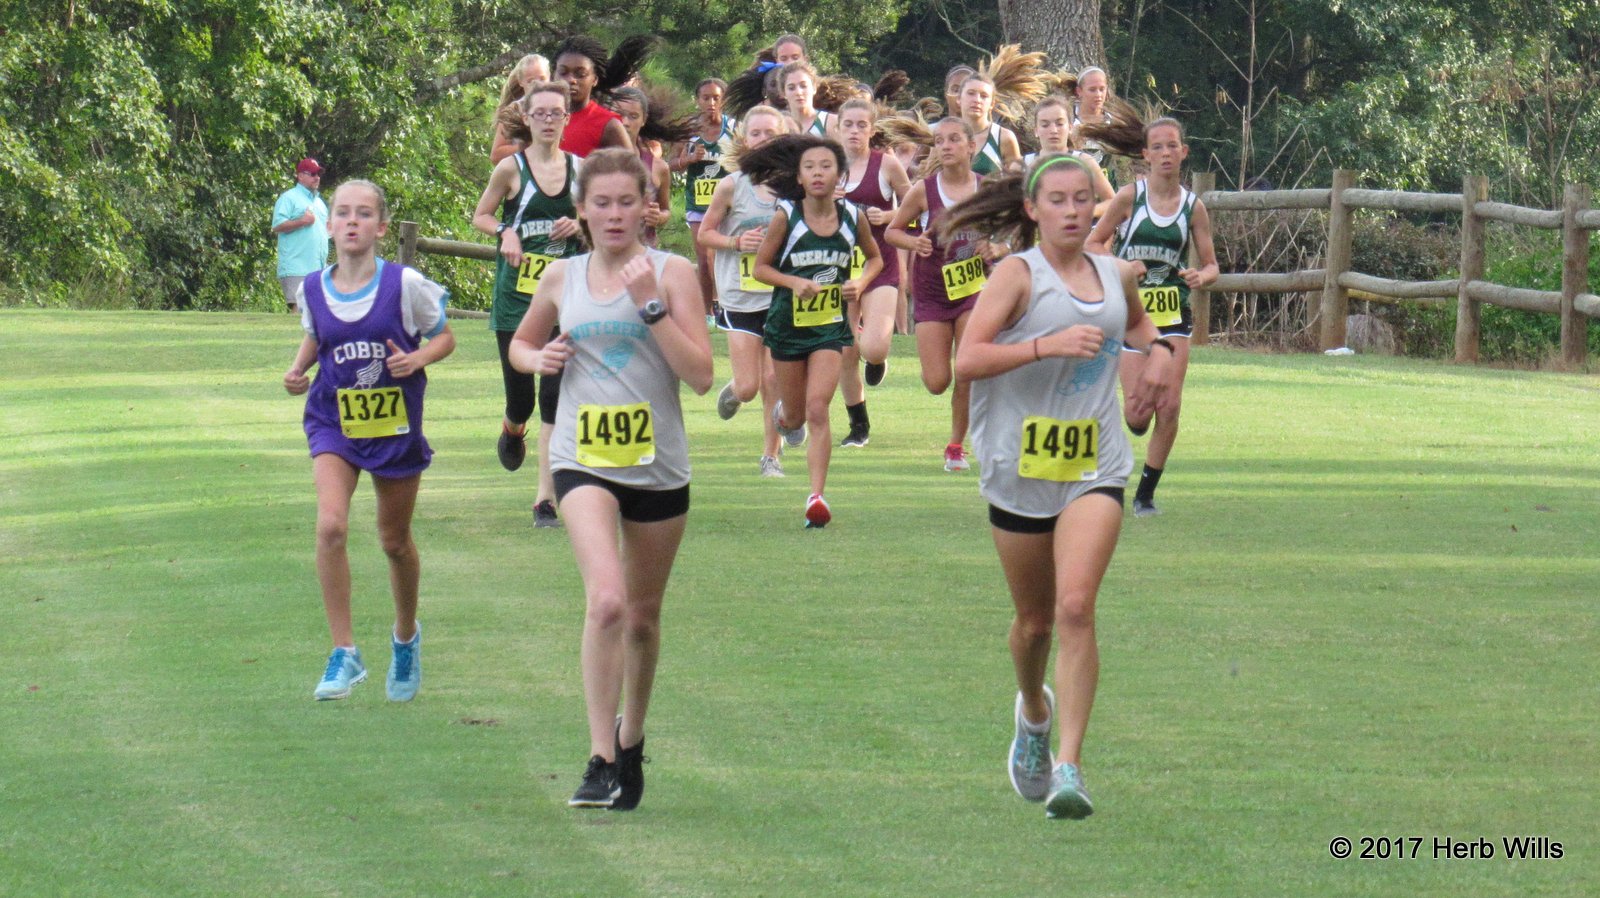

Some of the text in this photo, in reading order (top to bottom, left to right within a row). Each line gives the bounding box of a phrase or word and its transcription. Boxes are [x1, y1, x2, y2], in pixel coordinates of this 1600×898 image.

[697, 181, 718, 196] 127
[521, 220, 553, 239] DEER
[522, 257, 552, 281] 12
[945, 258, 982, 288] 1398
[1144, 289, 1179, 313] 280
[333, 341, 386, 365] COBB
[341, 391, 400, 421] 1327
[580, 409, 652, 446] 1492
[1024, 422, 1095, 460] 1491
